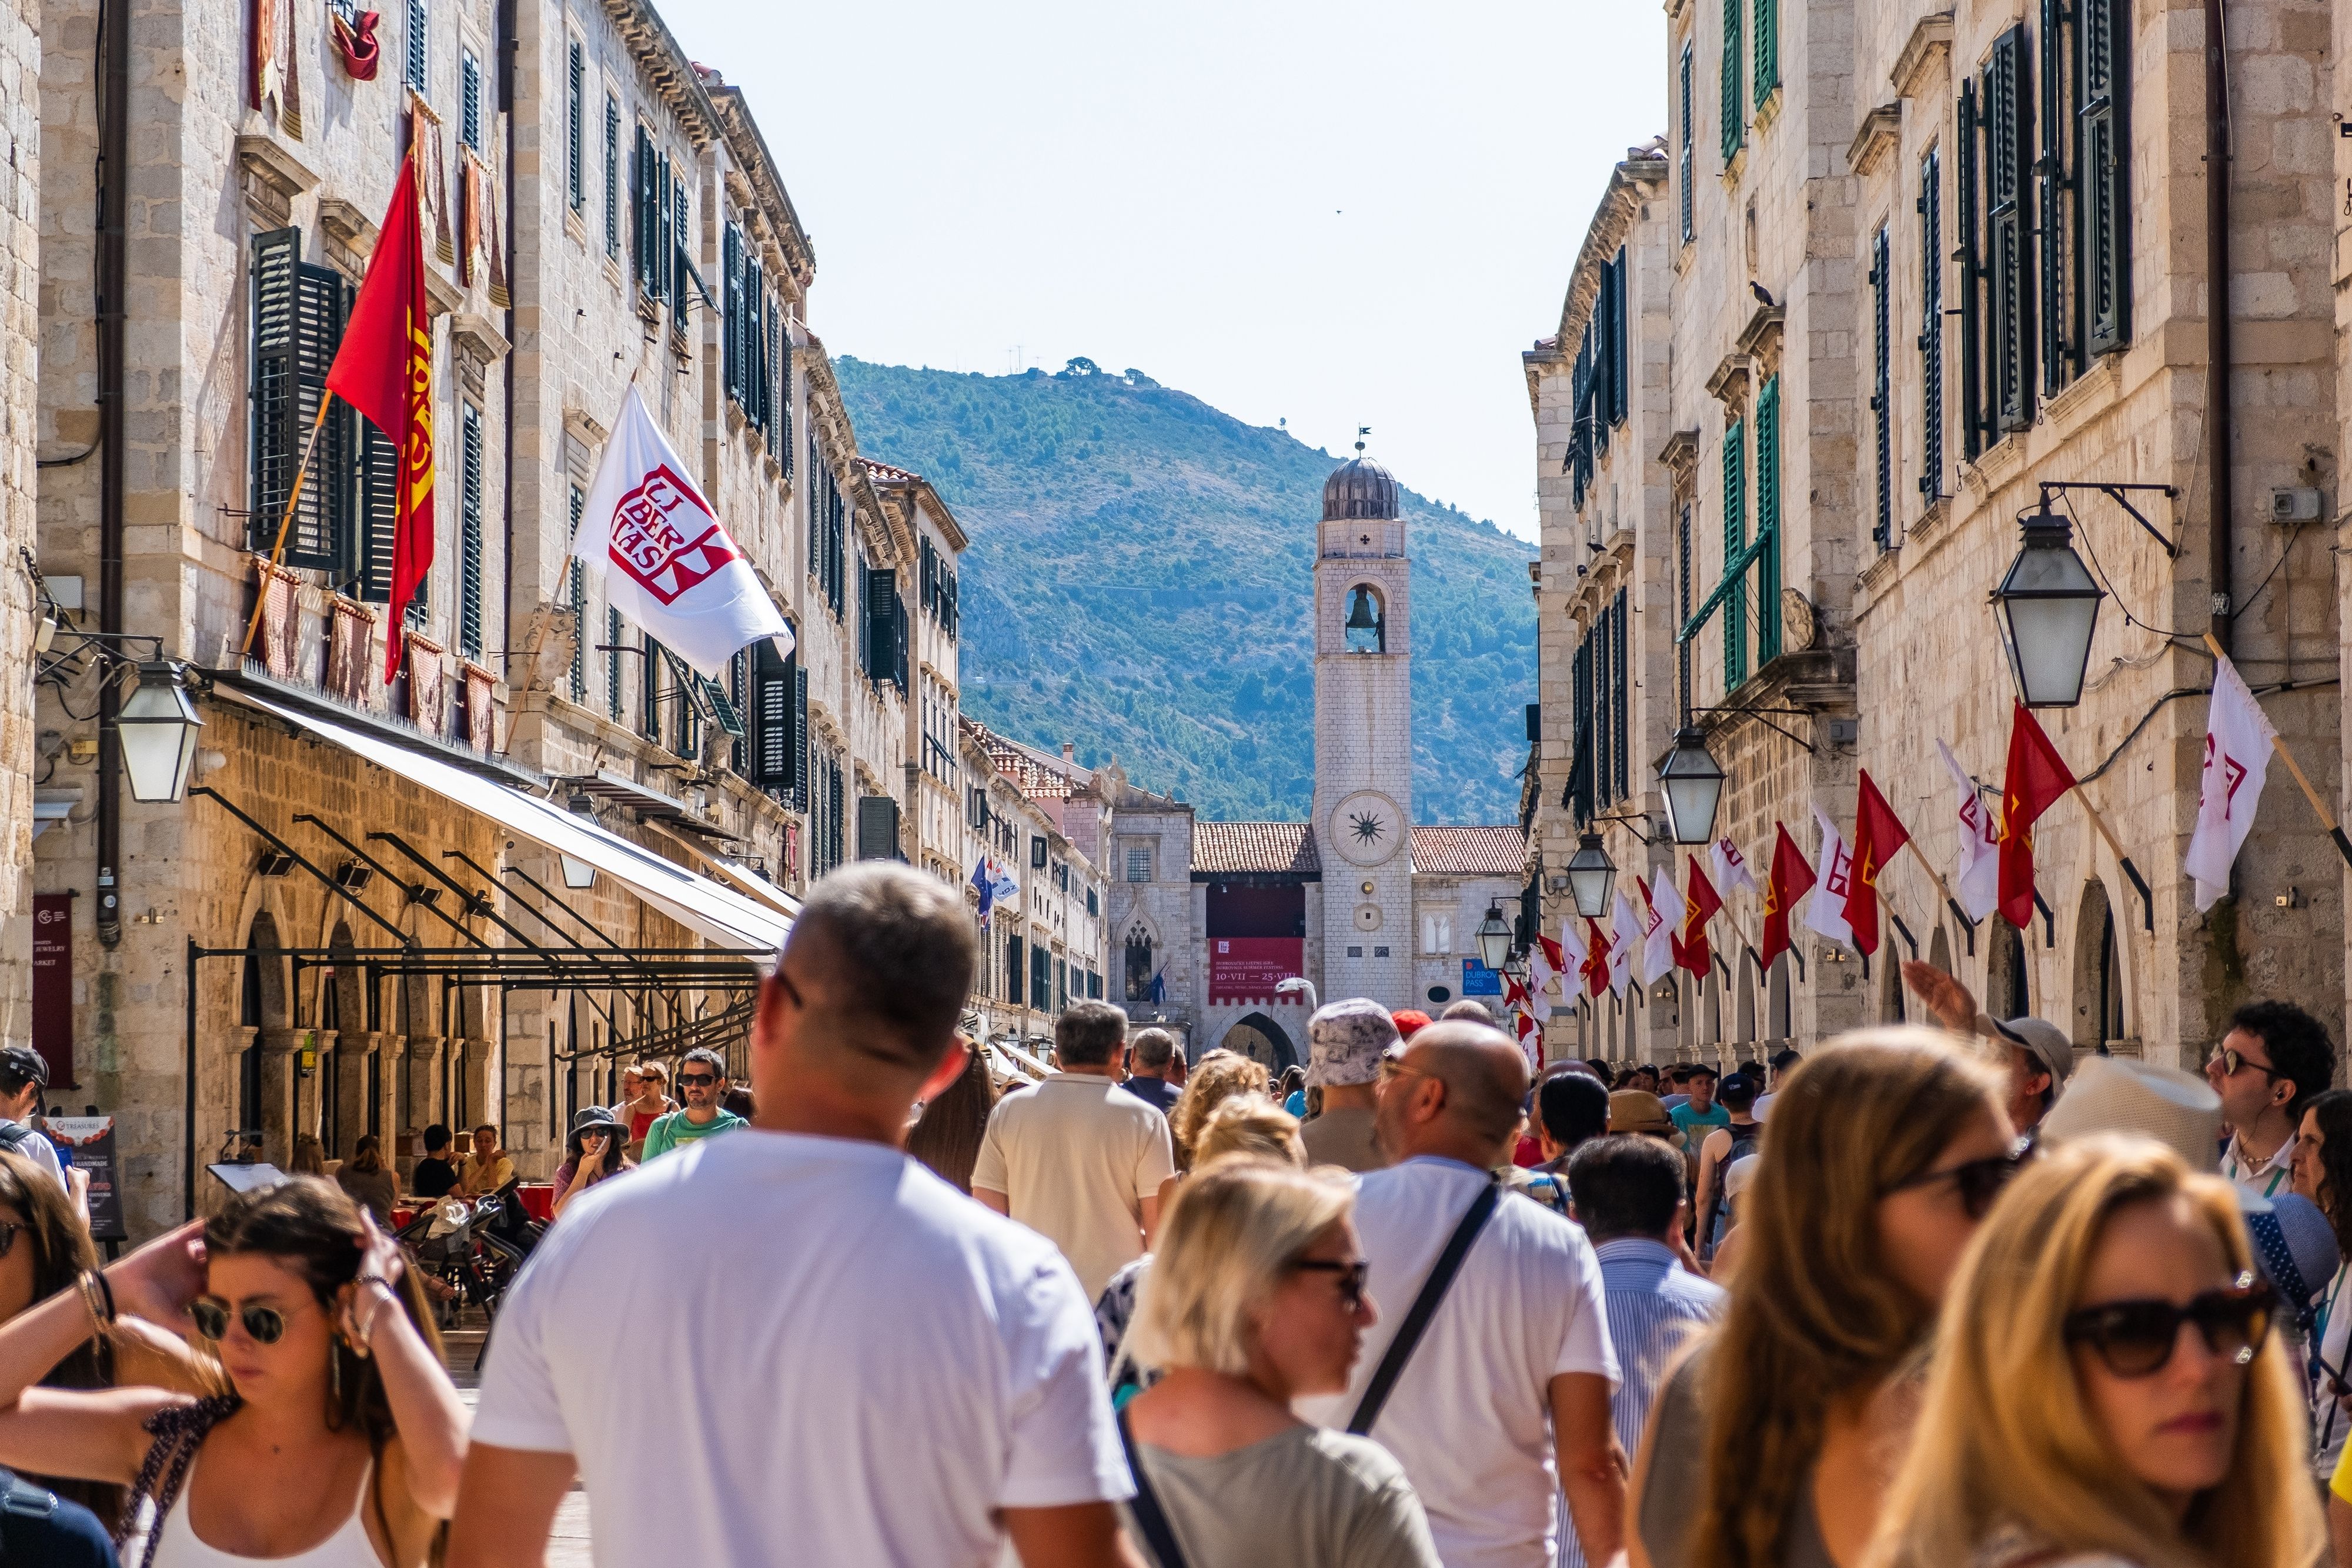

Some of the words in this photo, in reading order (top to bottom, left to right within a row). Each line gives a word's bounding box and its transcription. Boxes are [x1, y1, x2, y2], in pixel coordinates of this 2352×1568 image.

[646, 482, 684, 514] LI
[612, 513, 664, 569] TAS
[624, 499, 684, 551] BER
[1375, 947, 1388, 956] 25
[1466, 979, 1484, 987] PASS
